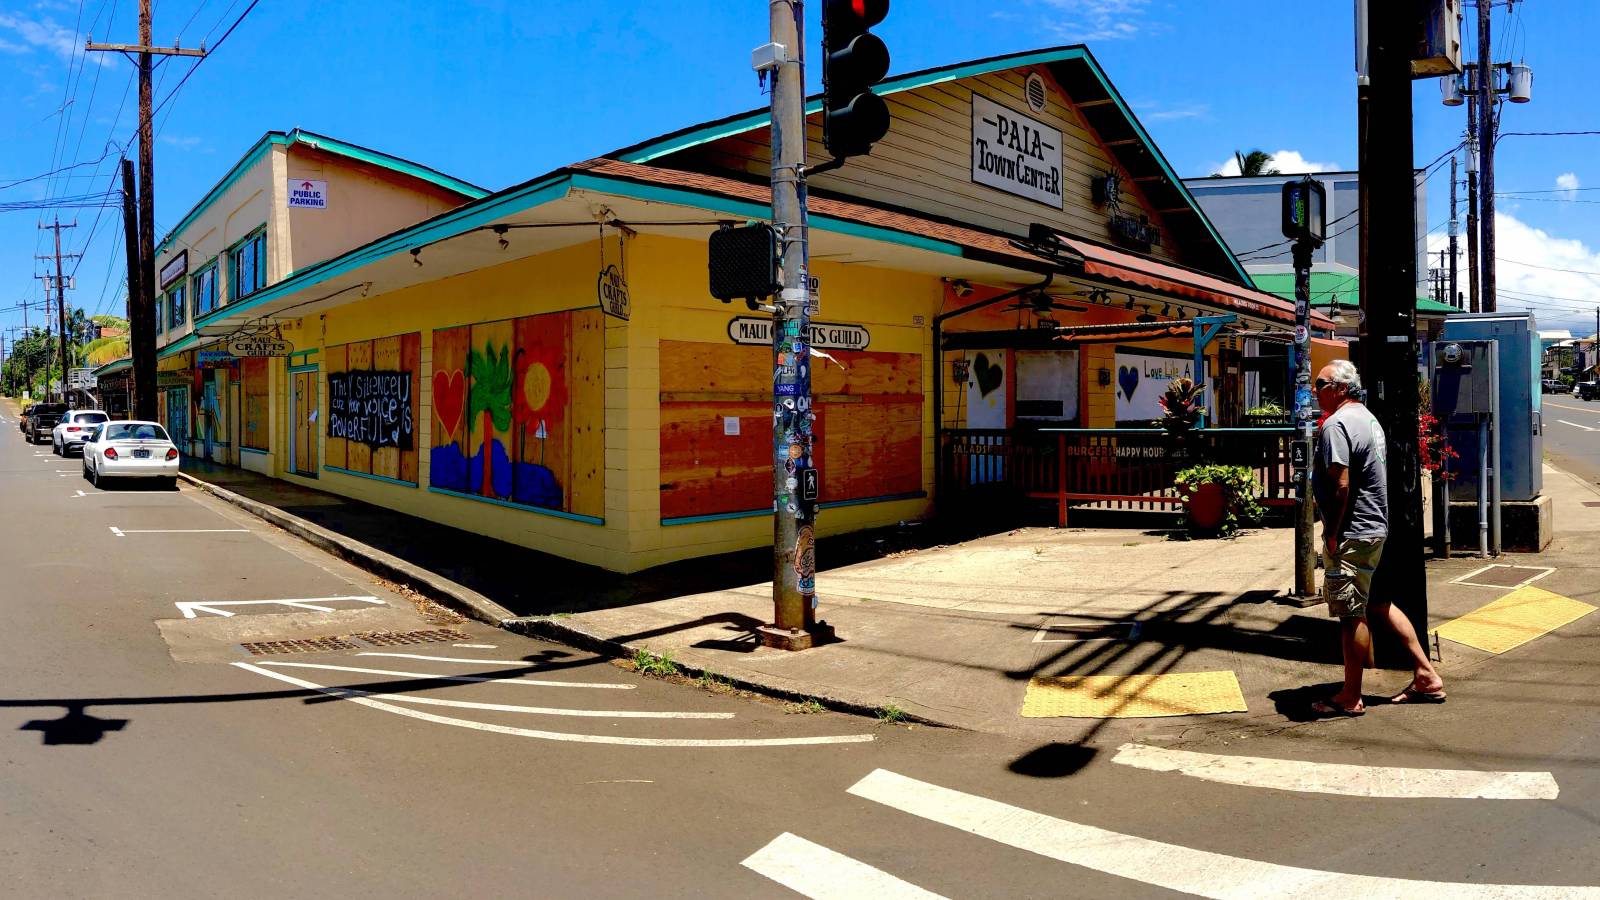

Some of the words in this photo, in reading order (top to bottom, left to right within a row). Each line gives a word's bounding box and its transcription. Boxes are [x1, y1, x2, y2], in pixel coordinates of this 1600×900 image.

[293, 190, 321, 199] PUBLIC
[290, 198, 324, 206] PARKING
[739, 322, 768, 340] MAUI
[829, 331, 862, 346] GUILD
[235, 343, 286, 351] CRAFTS
[1144, 360, 1162, 378] Love
[777, 384, 795, 392] YANG
[1115, 447, 1141, 457] HAPPY
